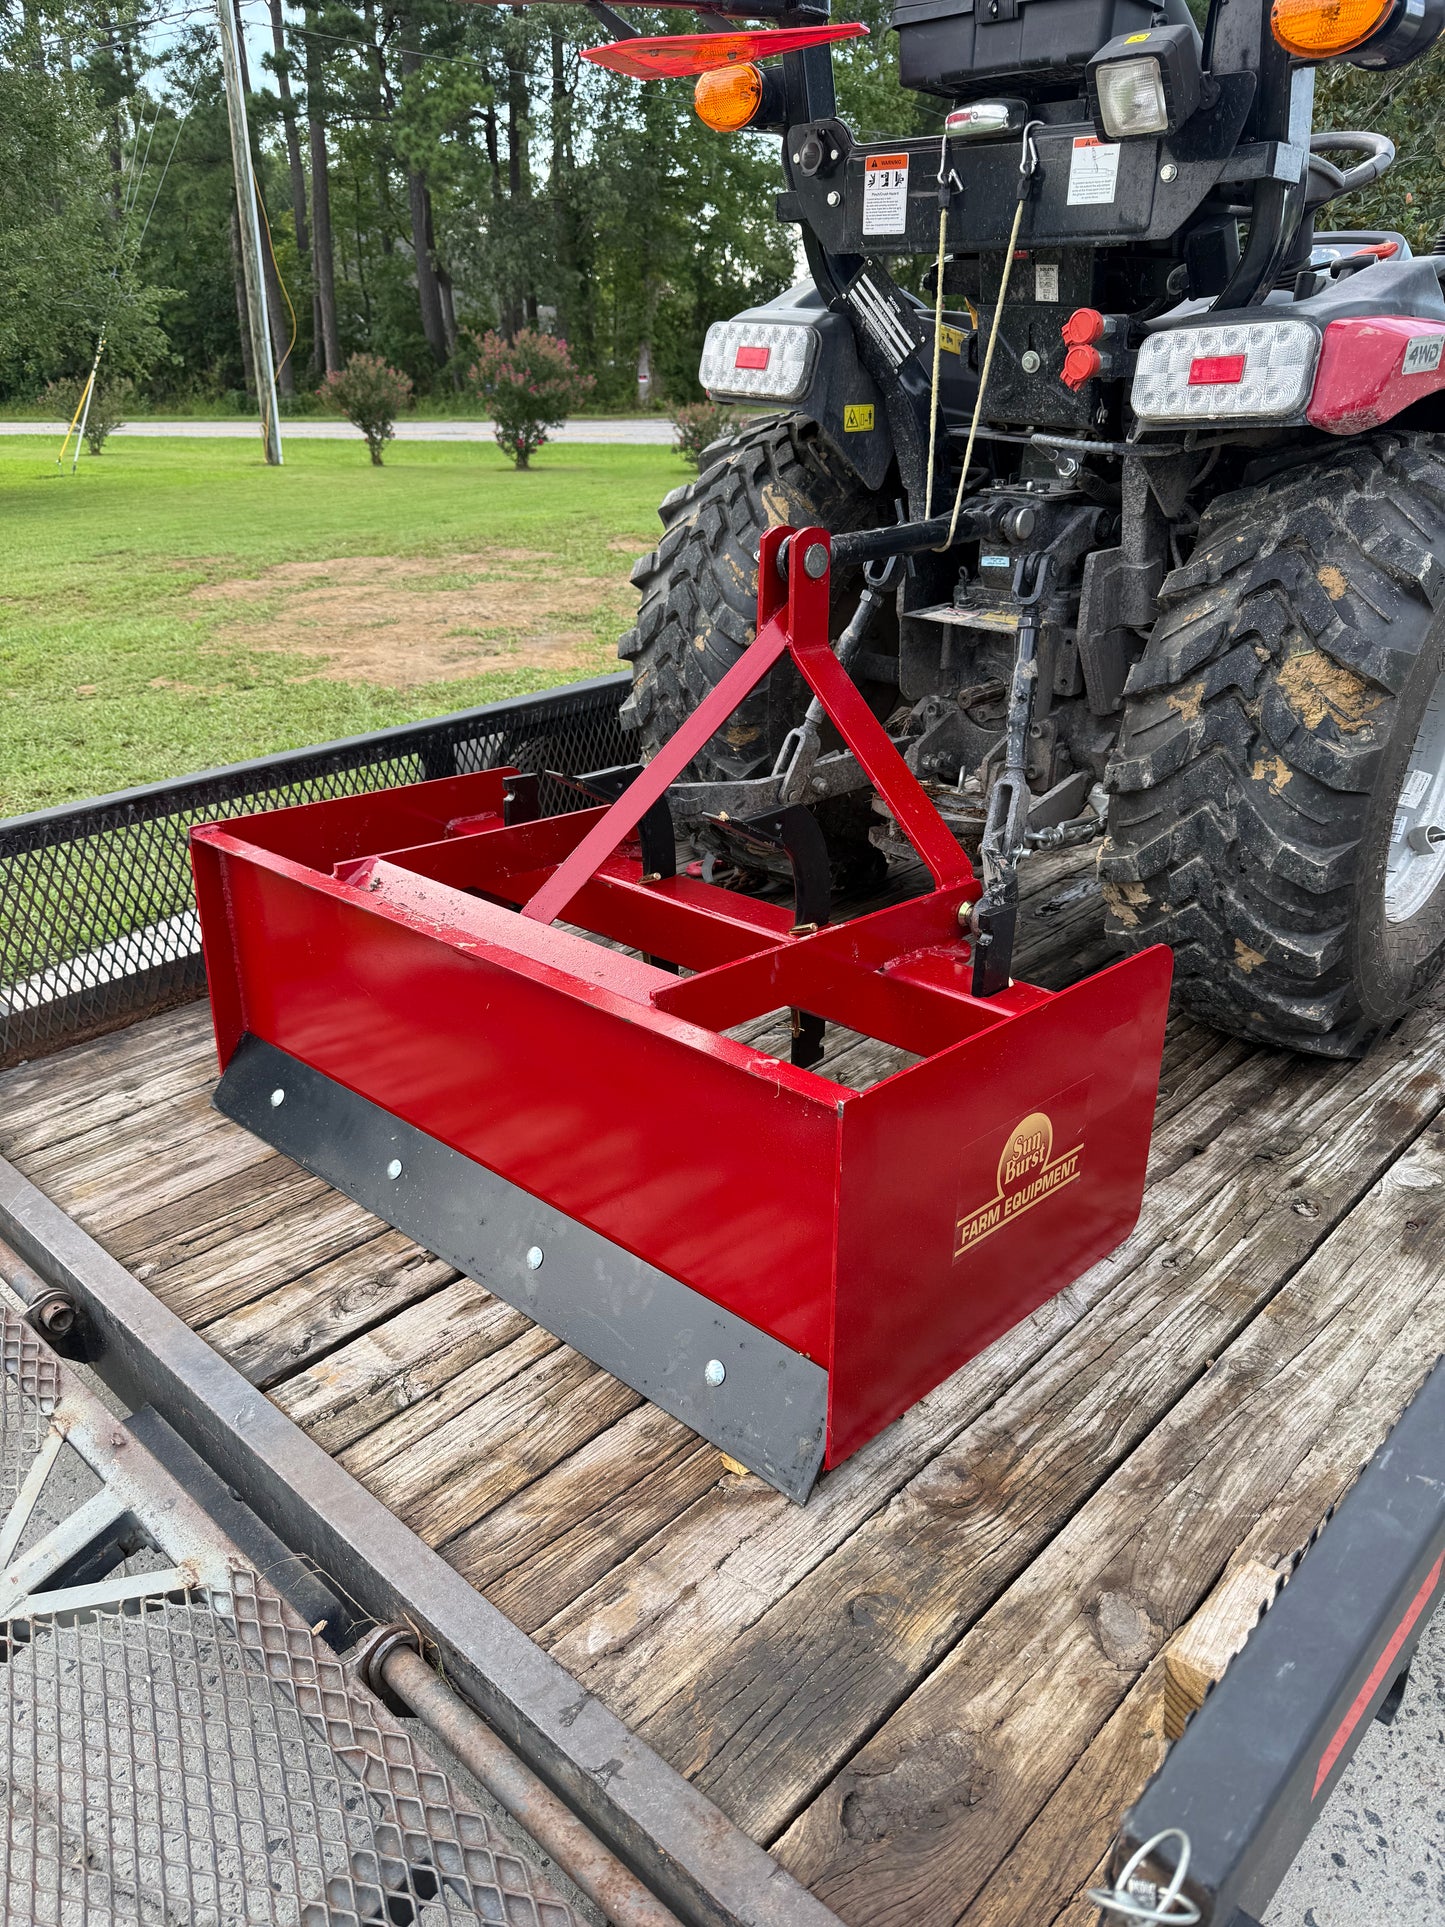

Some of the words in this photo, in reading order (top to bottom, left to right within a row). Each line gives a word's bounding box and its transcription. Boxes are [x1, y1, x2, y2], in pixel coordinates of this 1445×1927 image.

[1409, 343, 1439, 366] 4WD
[1004, 1142, 1046, 1185] Burst
[1012, 1131, 1042, 1161] Sun
[961, 1204, 1000, 1244] FARM
[1004, 1155, 1079, 1216] EQUIPMENT
